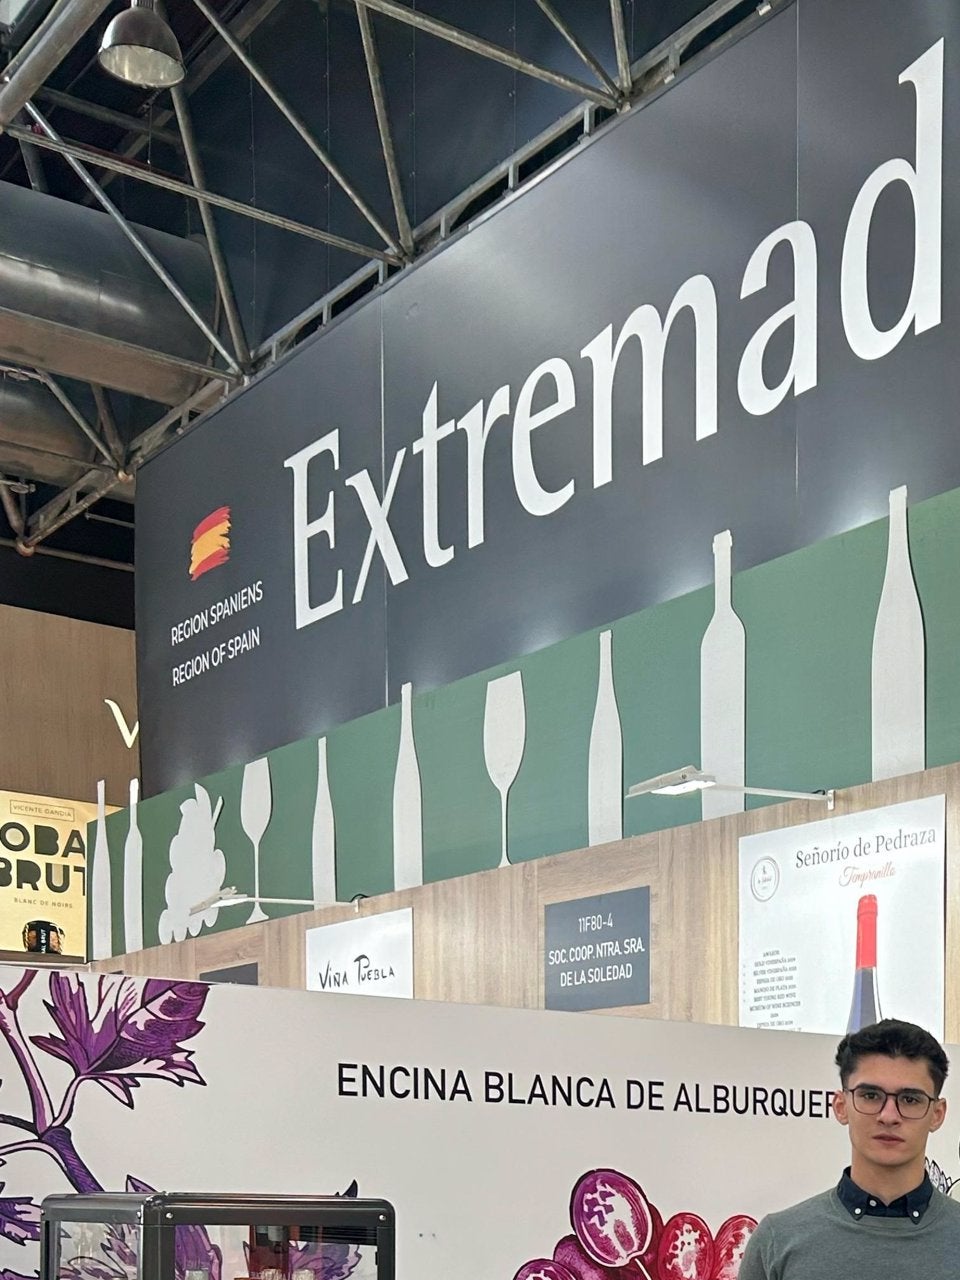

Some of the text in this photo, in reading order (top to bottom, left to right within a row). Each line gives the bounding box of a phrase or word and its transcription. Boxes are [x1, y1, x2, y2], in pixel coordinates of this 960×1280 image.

[171, 580, 263, 647] REGION SPANIENS
[172, 626, 260, 687] REGION OF SPAIN
[795, 828, 937, 869] Señorío de Pedraza
[578, 912, 614, 933] 11F80-4
[569, 944, 596, 963] COOP.
[560, 962, 633, 987] DE LA SOLEDAD
[337, 1062, 472, 1103] ENCINA
[484, 1071, 616, 1109] BLANCA
[626, 1079, 664, 1110] DE
